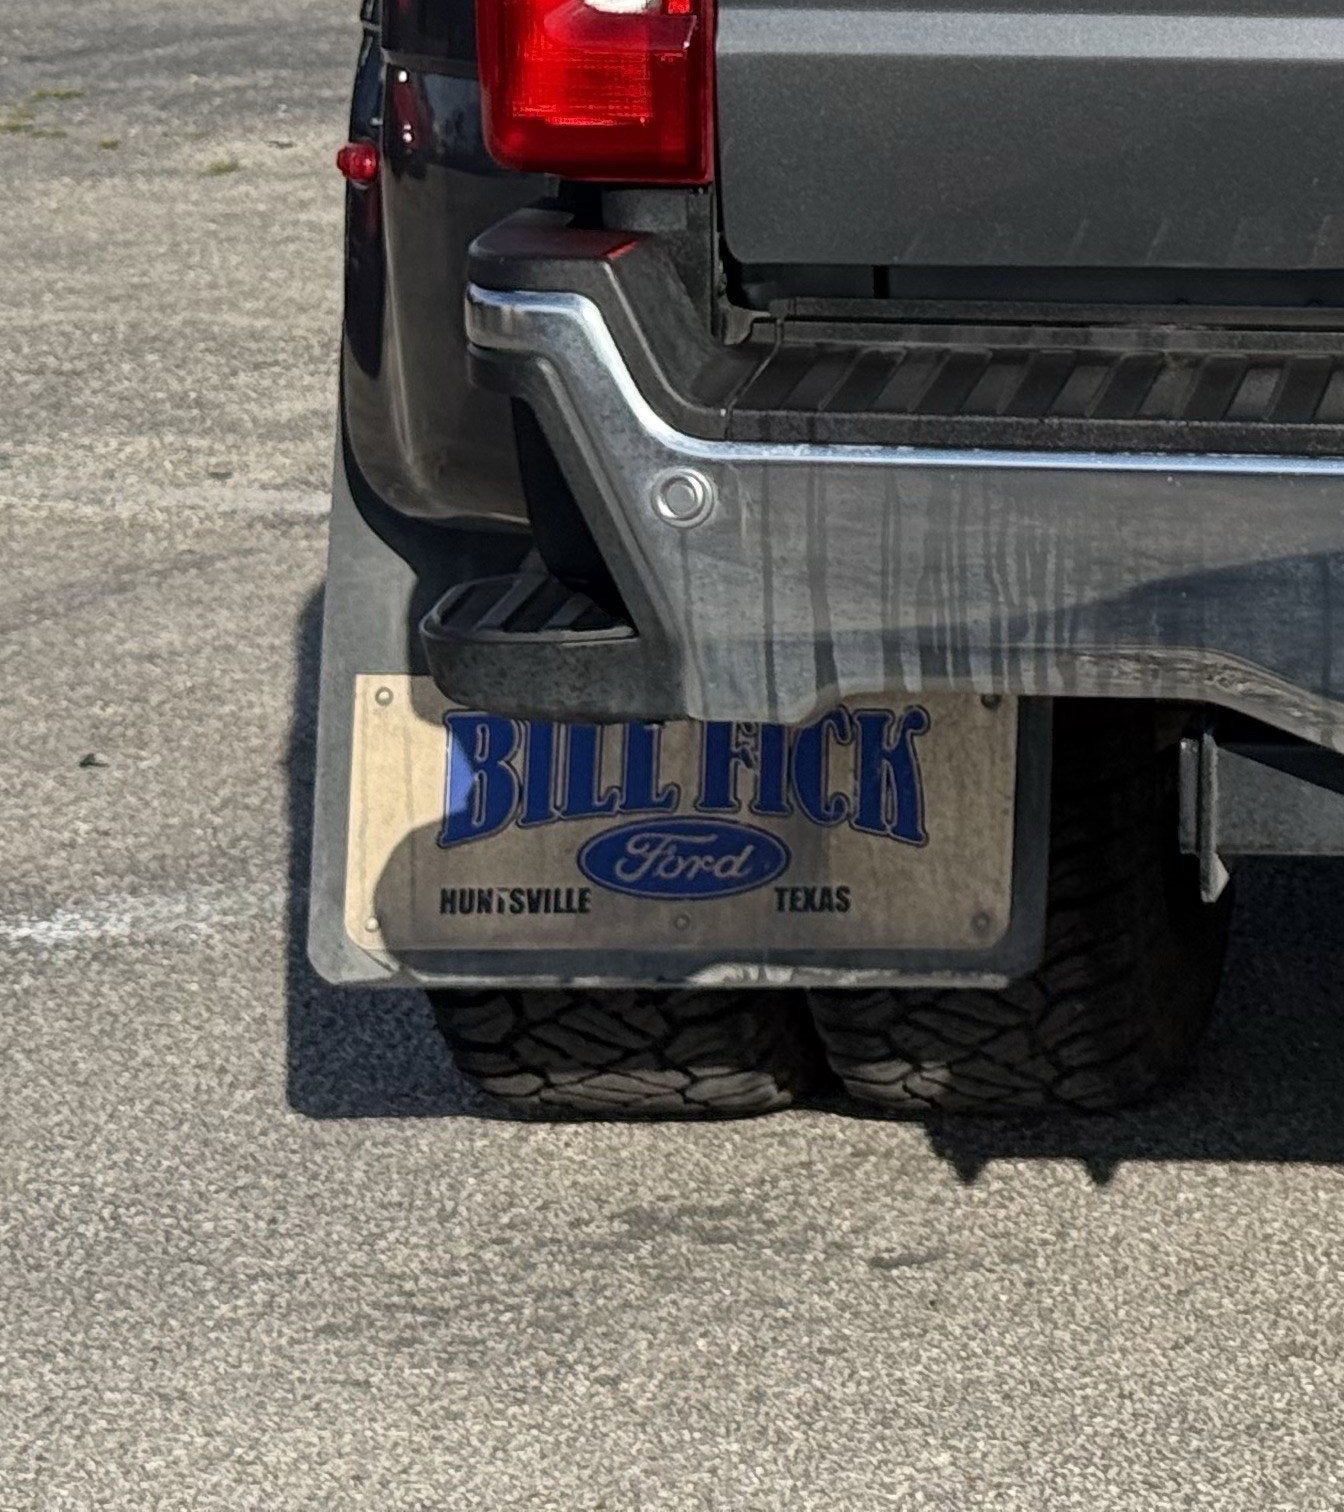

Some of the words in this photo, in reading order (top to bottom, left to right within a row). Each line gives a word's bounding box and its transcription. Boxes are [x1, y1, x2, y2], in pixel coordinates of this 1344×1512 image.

[614, 832, 755, 883] Ford
[439, 887, 592, 915] HUNTSVILLE
[775, 886, 851, 914] TEXAS
